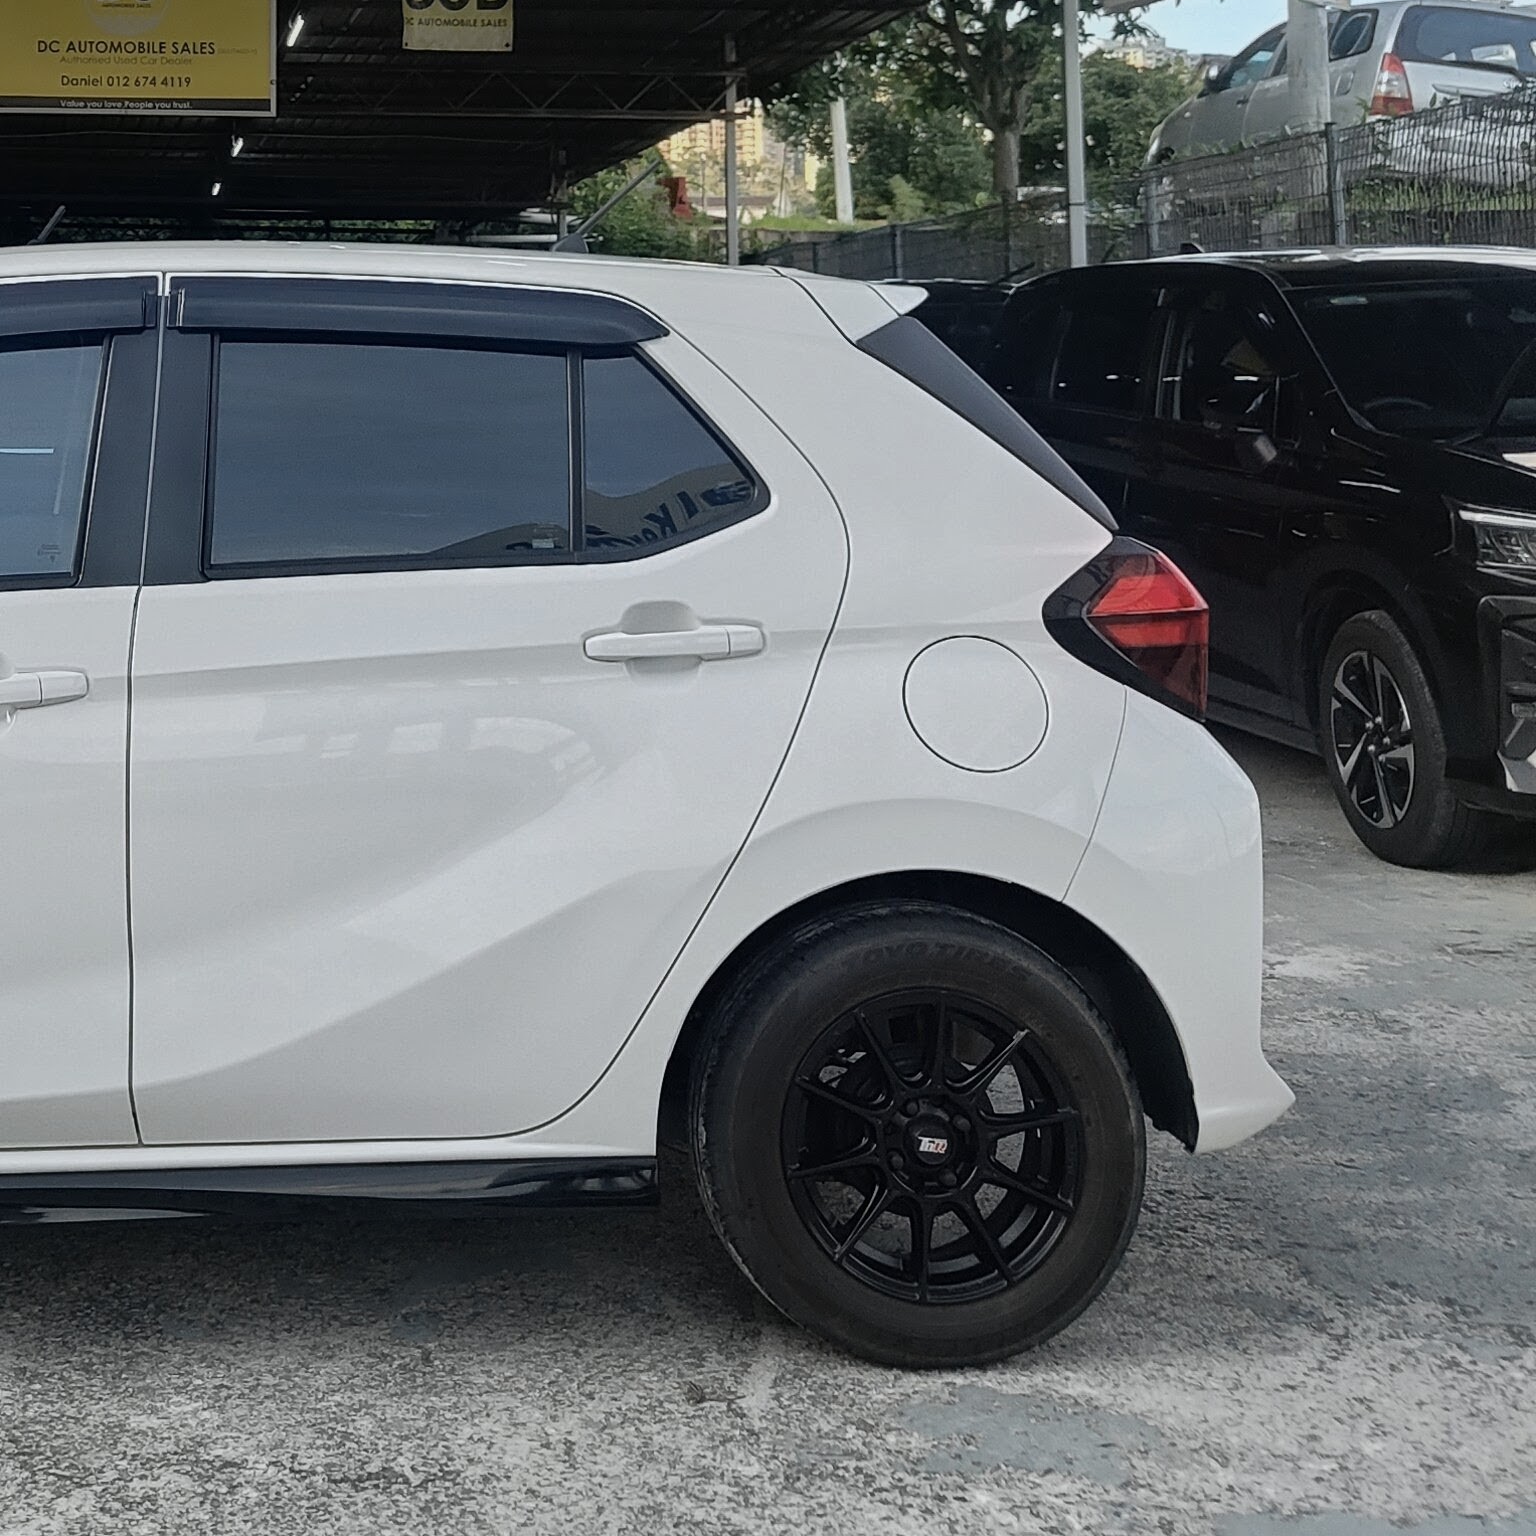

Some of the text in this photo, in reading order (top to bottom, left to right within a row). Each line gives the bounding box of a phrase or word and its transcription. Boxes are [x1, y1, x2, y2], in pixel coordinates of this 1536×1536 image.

[418, 17, 477, 27] AUTOMOBILE
[481, 18, 508, 27] SALES
[37, 40, 60, 53] DC
[65, 40, 166, 54] AUTOMOBILE
[172, 41, 215, 54] SALES
[59, 55, 192, 65] Authorised Used Car Dealer
[61, 75, 191, 87] Daniel 012 674 4119
[60, 99, 85, 107] Value
[86, 101, 103, 109] you
[154, 102, 171, 110] you
